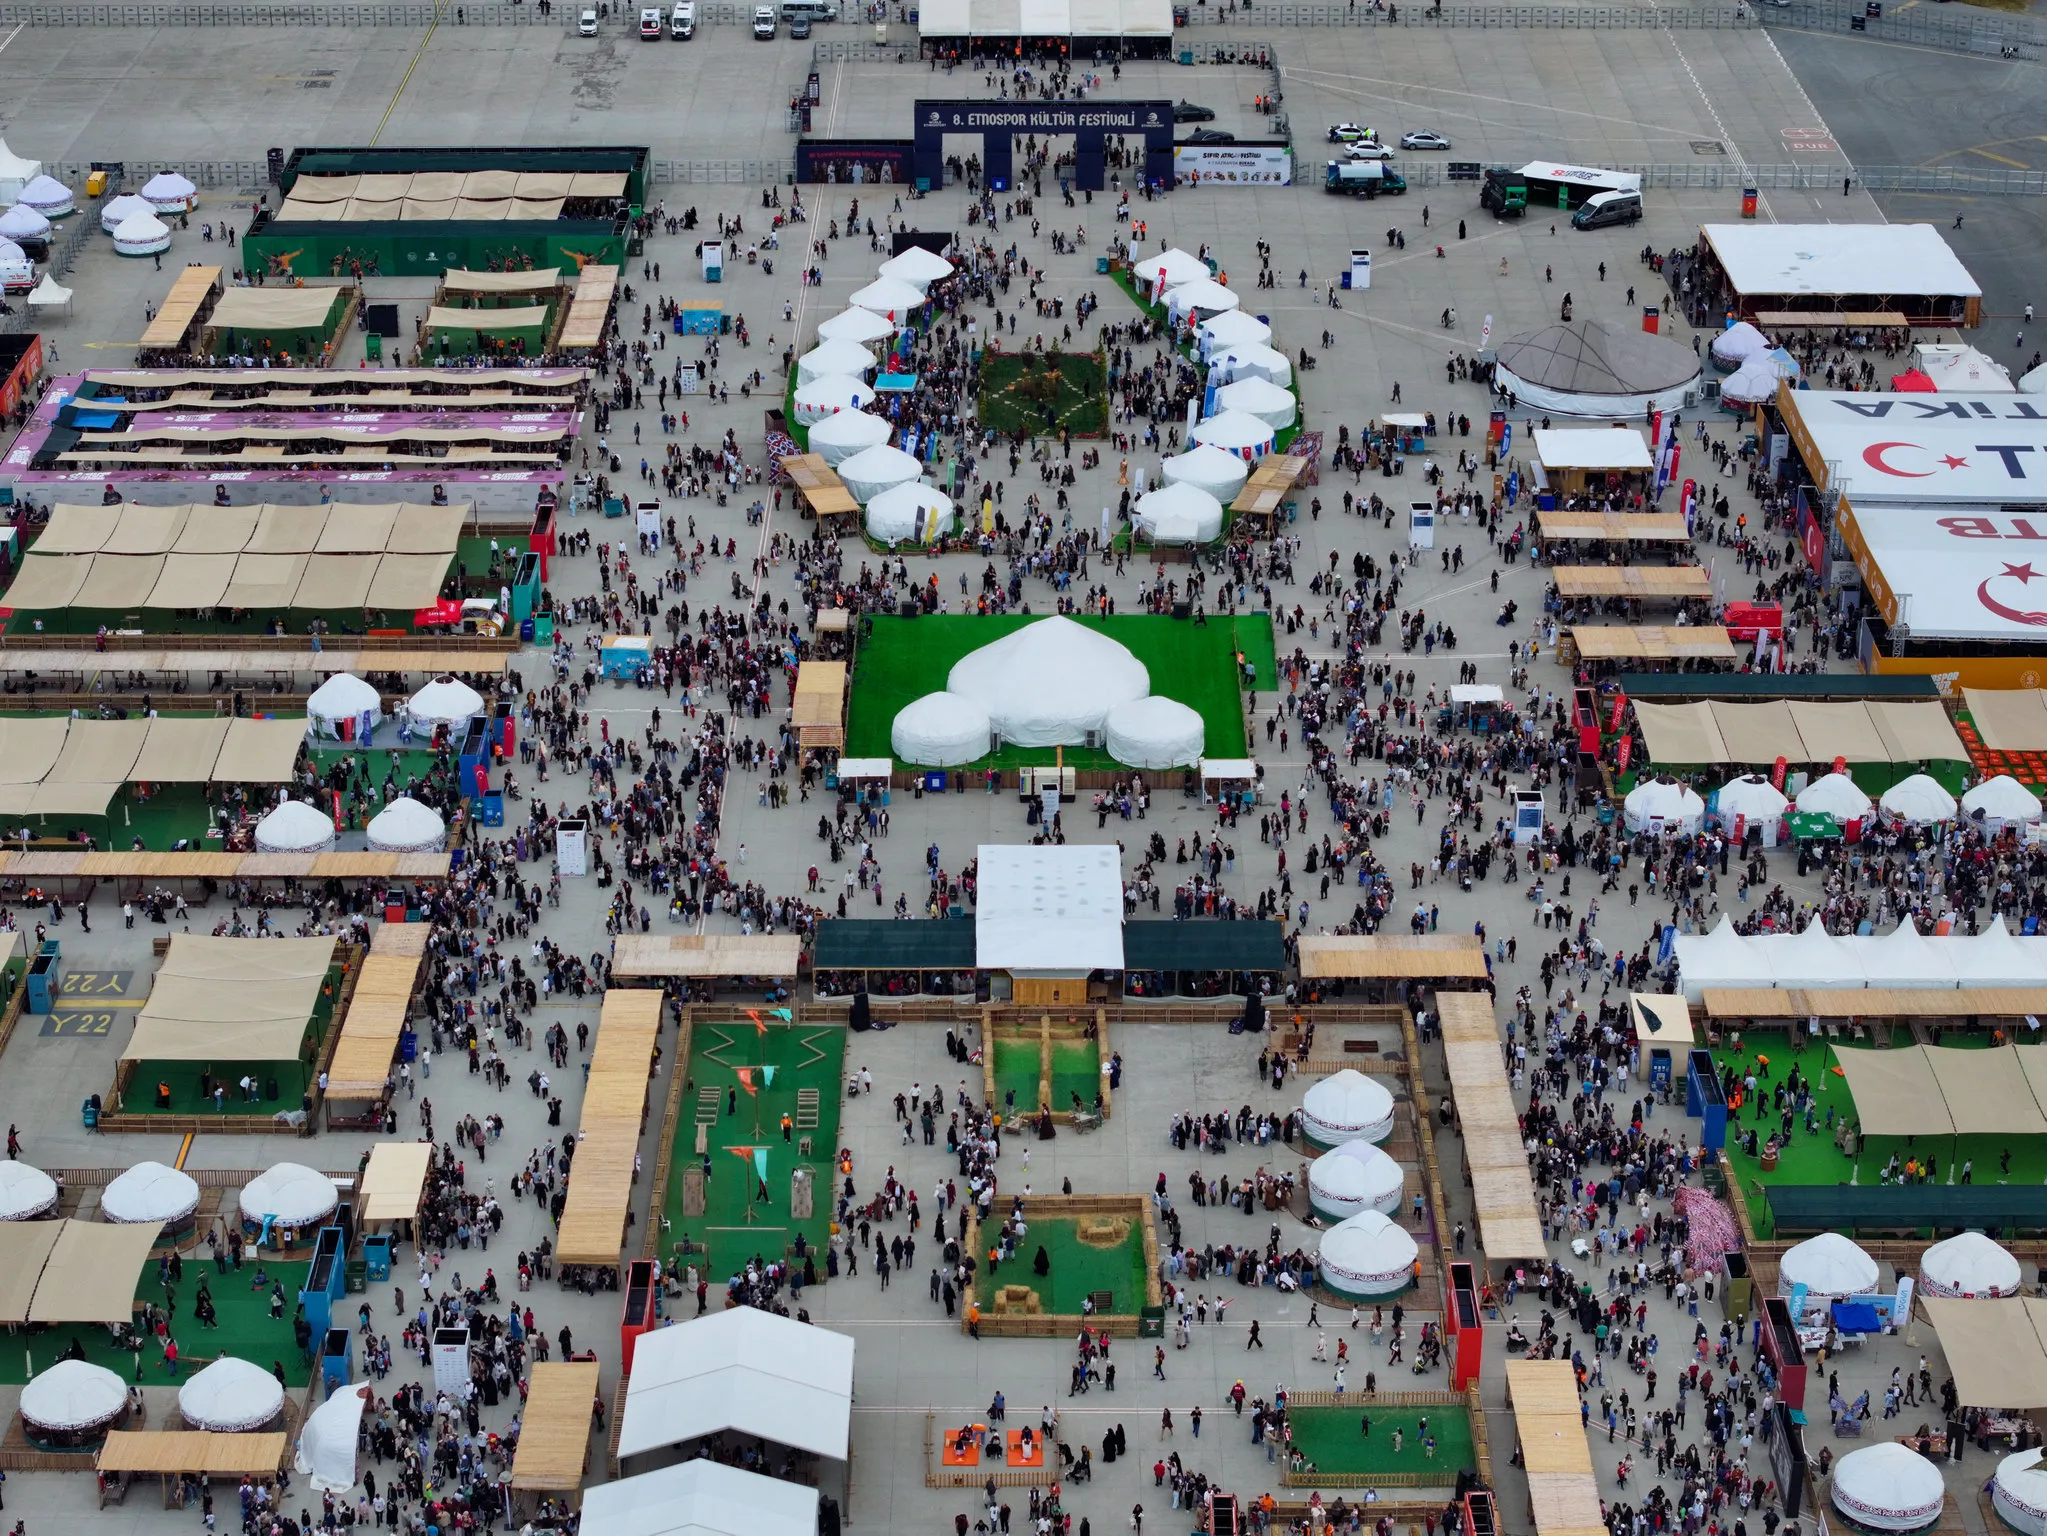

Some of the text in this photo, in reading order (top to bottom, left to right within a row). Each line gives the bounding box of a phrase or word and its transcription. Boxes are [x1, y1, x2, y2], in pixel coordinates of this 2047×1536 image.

[952, 114, 965, 126] 8.
[1030, 111, 1075, 127] KÜLTÜR
[1079, 111, 1136, 127] FESTİVALİ
[1830, 400, 2047, 419] TİKA
